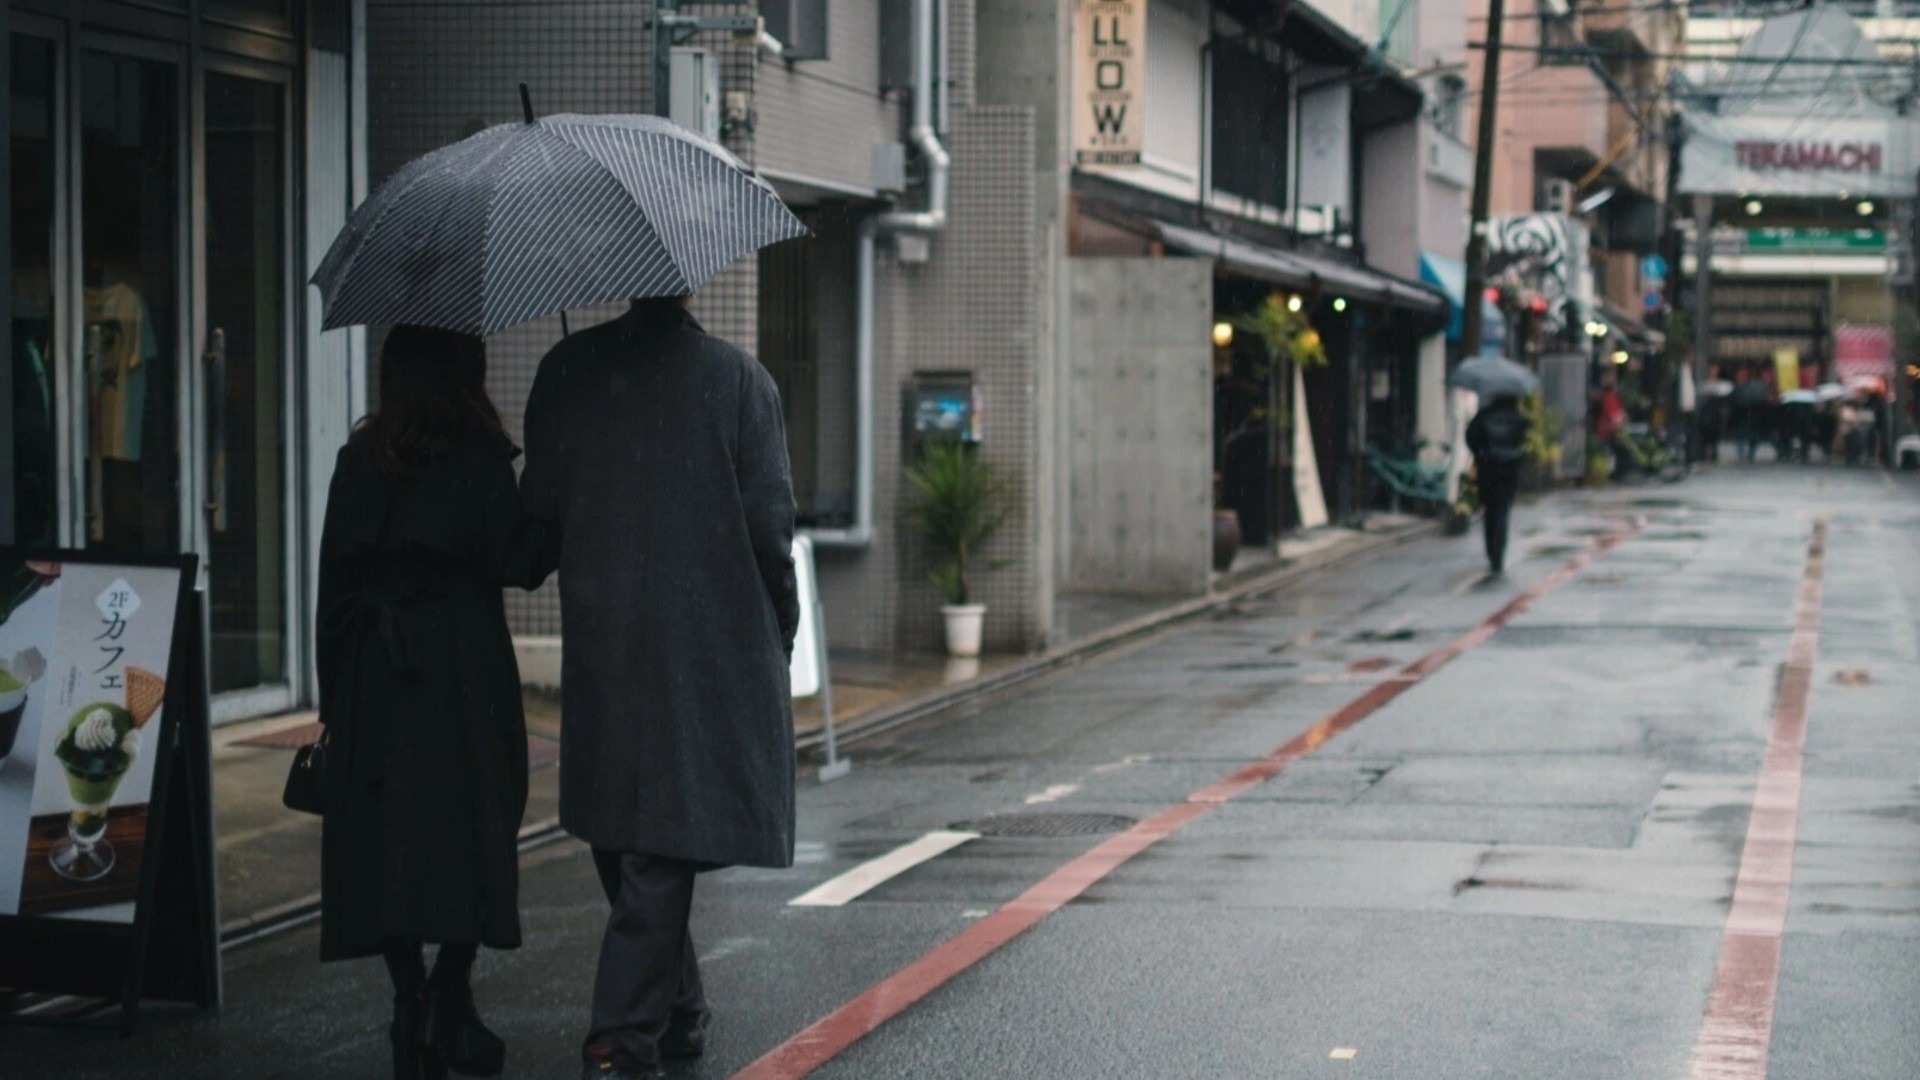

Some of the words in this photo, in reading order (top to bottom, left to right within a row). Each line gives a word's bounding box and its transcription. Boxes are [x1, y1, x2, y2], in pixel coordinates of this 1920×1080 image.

[108, 591, 130, 608] 2F
[93, 611, 127, 689] カフェ
